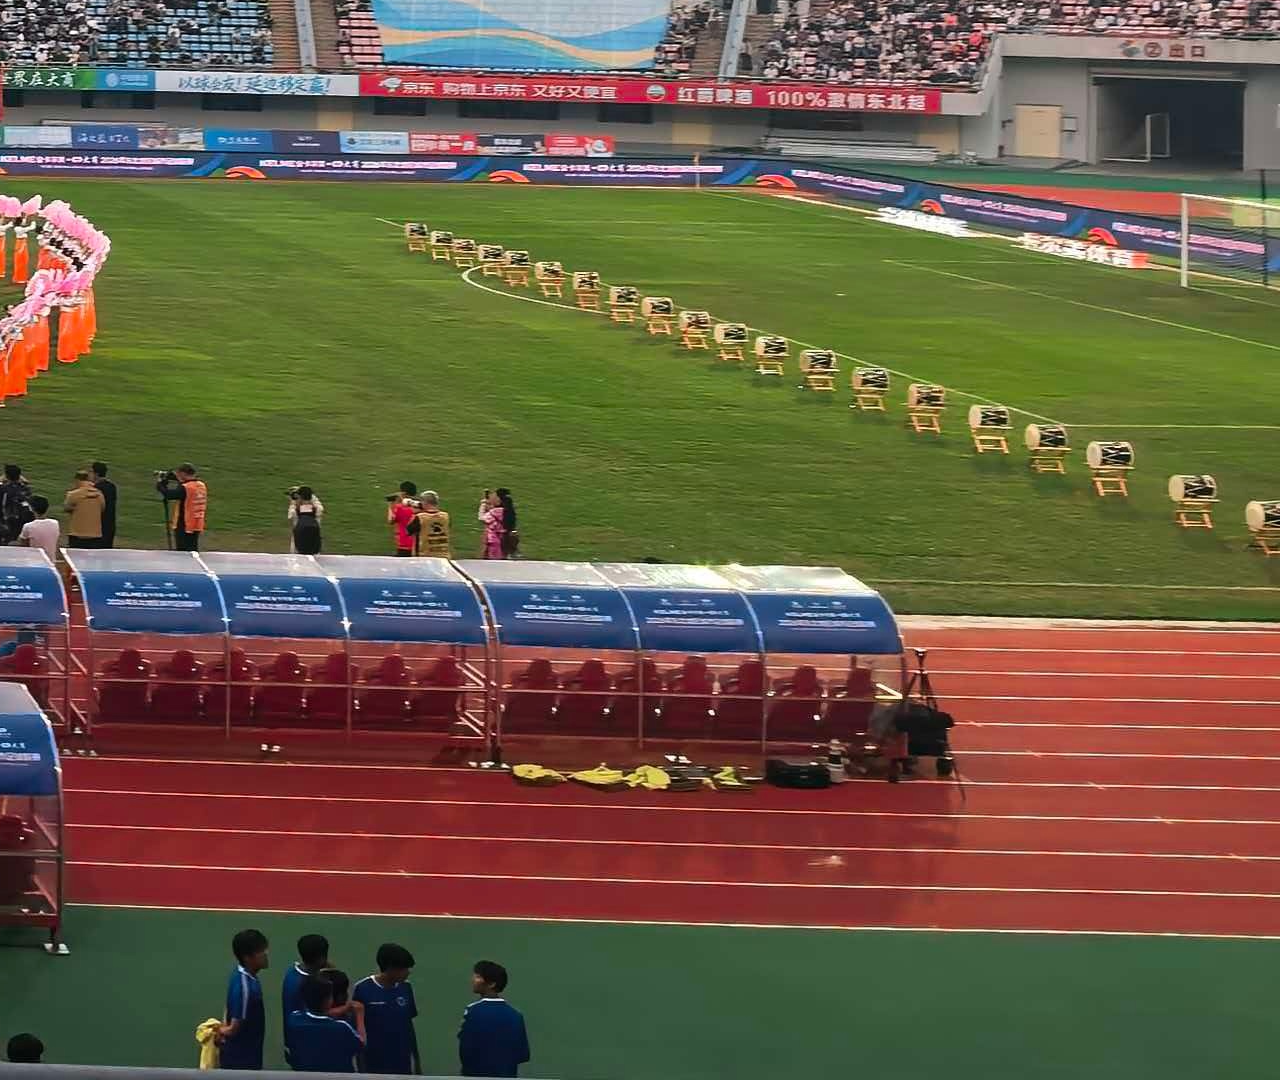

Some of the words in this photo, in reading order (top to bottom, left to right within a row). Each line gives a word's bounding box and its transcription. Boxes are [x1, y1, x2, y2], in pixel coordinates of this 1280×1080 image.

[442, 82, 526, 97] 购物上京东
[533, 84, 617, 100] 又好又便宜
